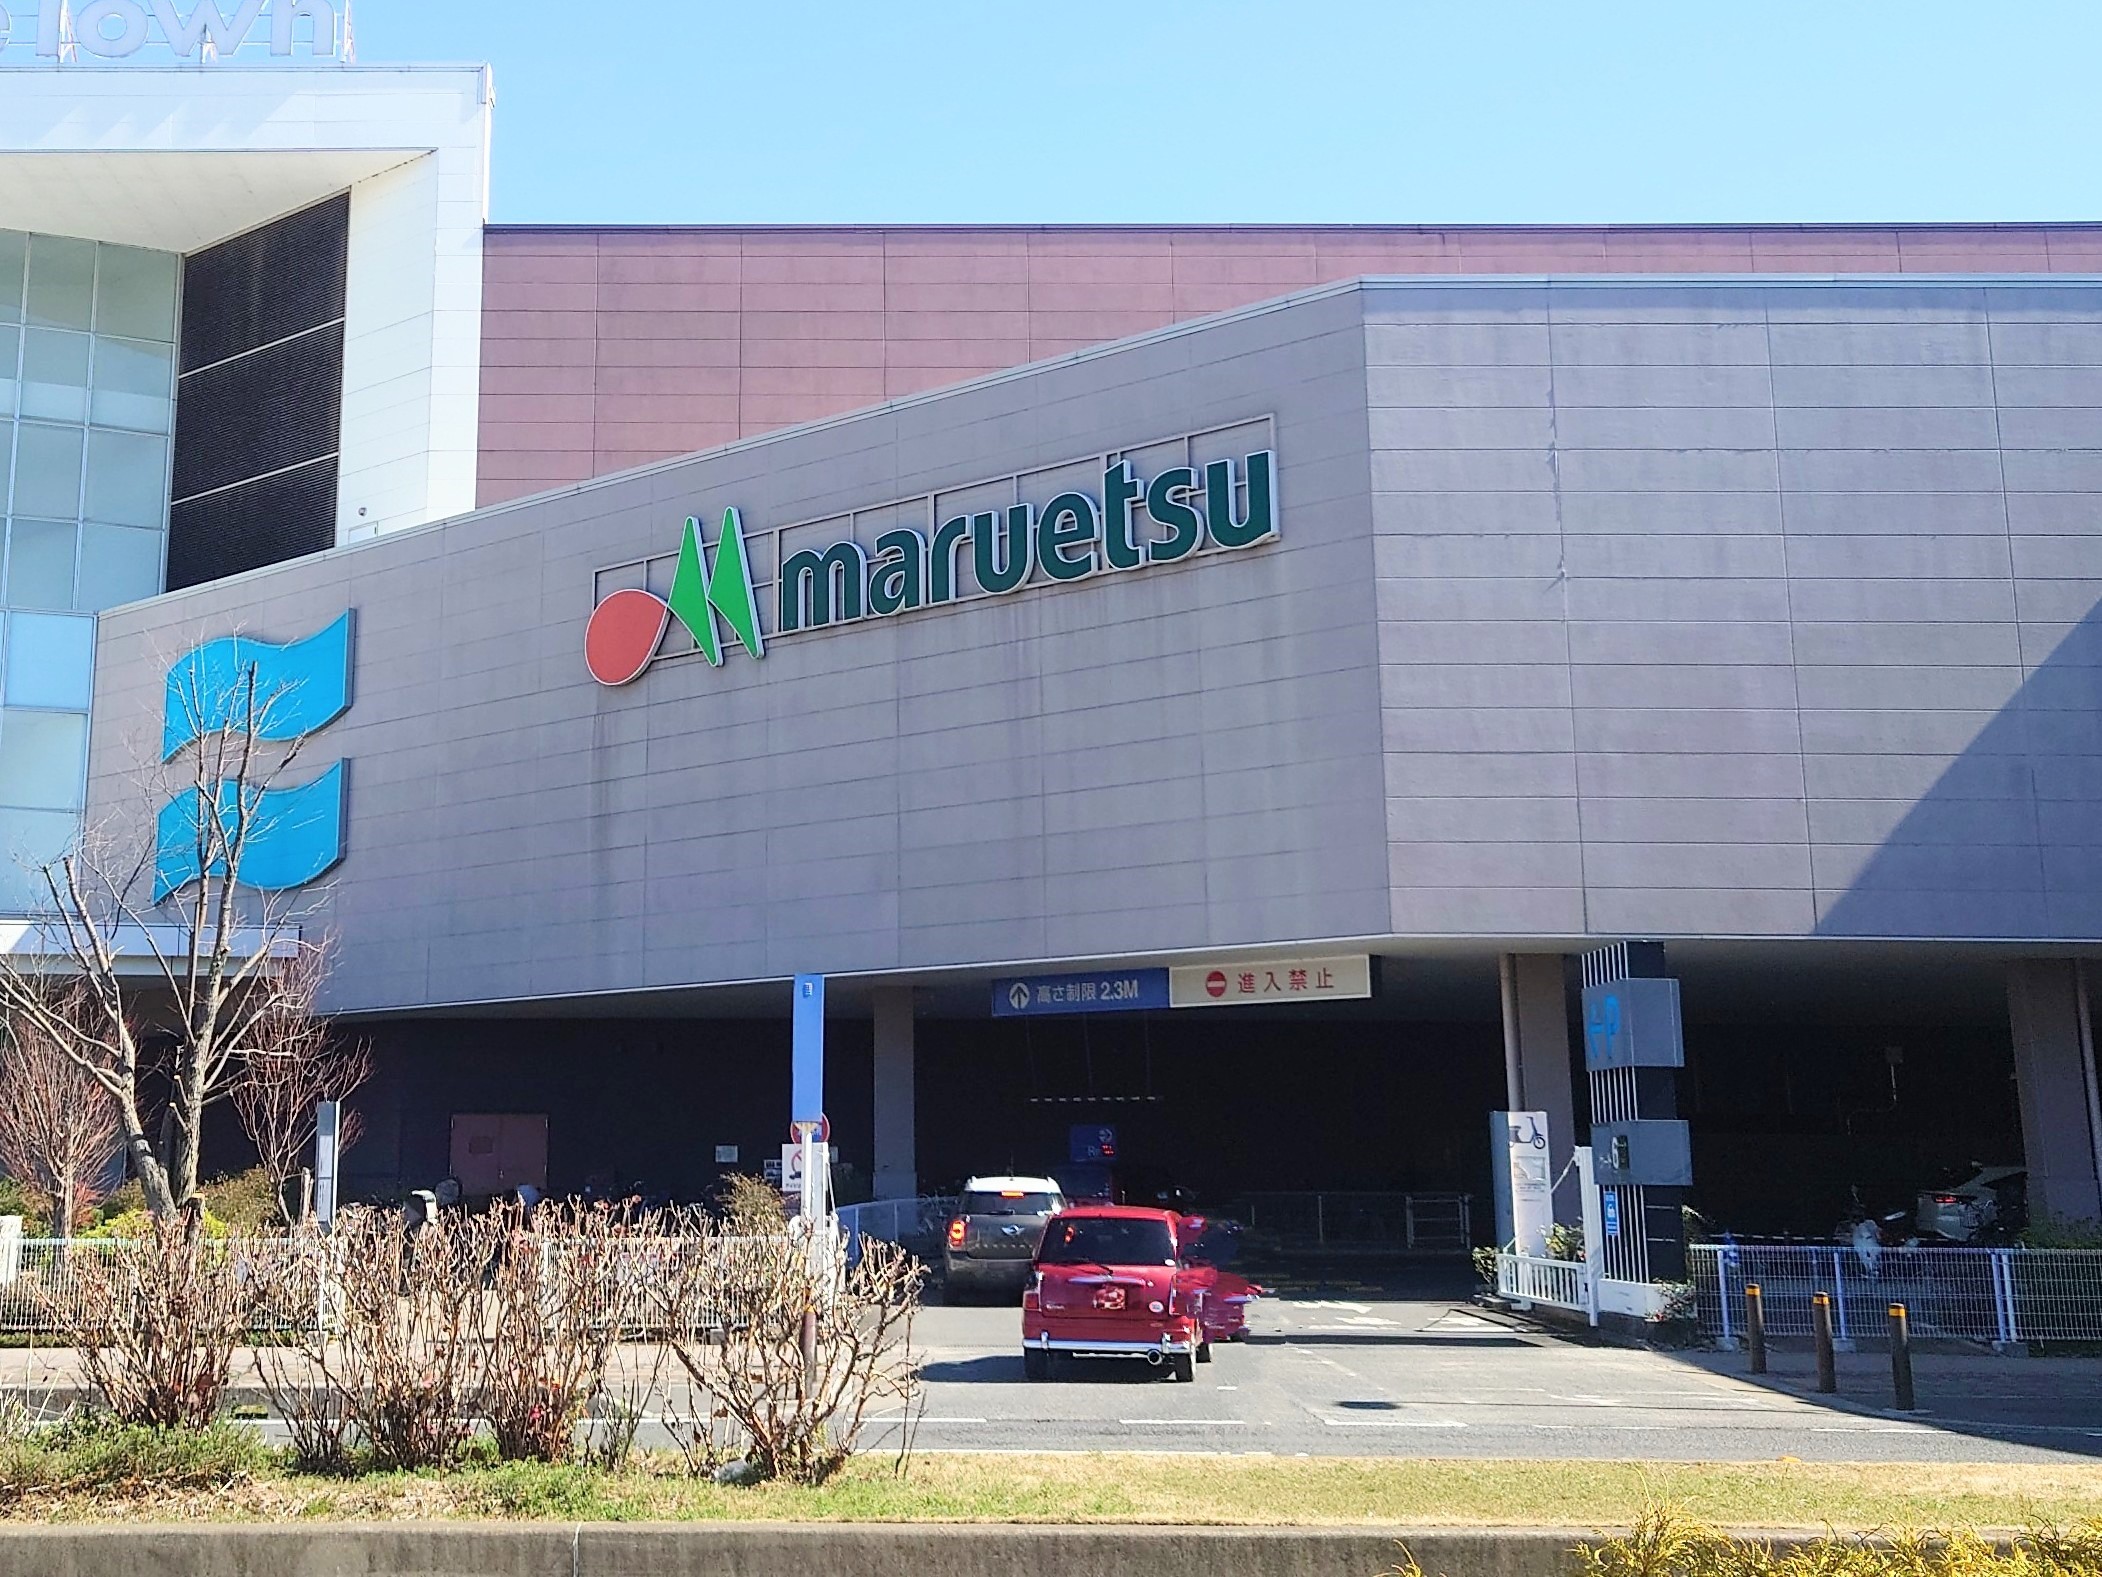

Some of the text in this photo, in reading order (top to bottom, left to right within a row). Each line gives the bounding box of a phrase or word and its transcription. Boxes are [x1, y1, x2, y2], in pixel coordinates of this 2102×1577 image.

[781, 449, 1276, 633] maruetsu
[1036, 979, 1139, 1005] 高さ制限 2.3M
[1237, 967, 1335, 994] 進入禁止
